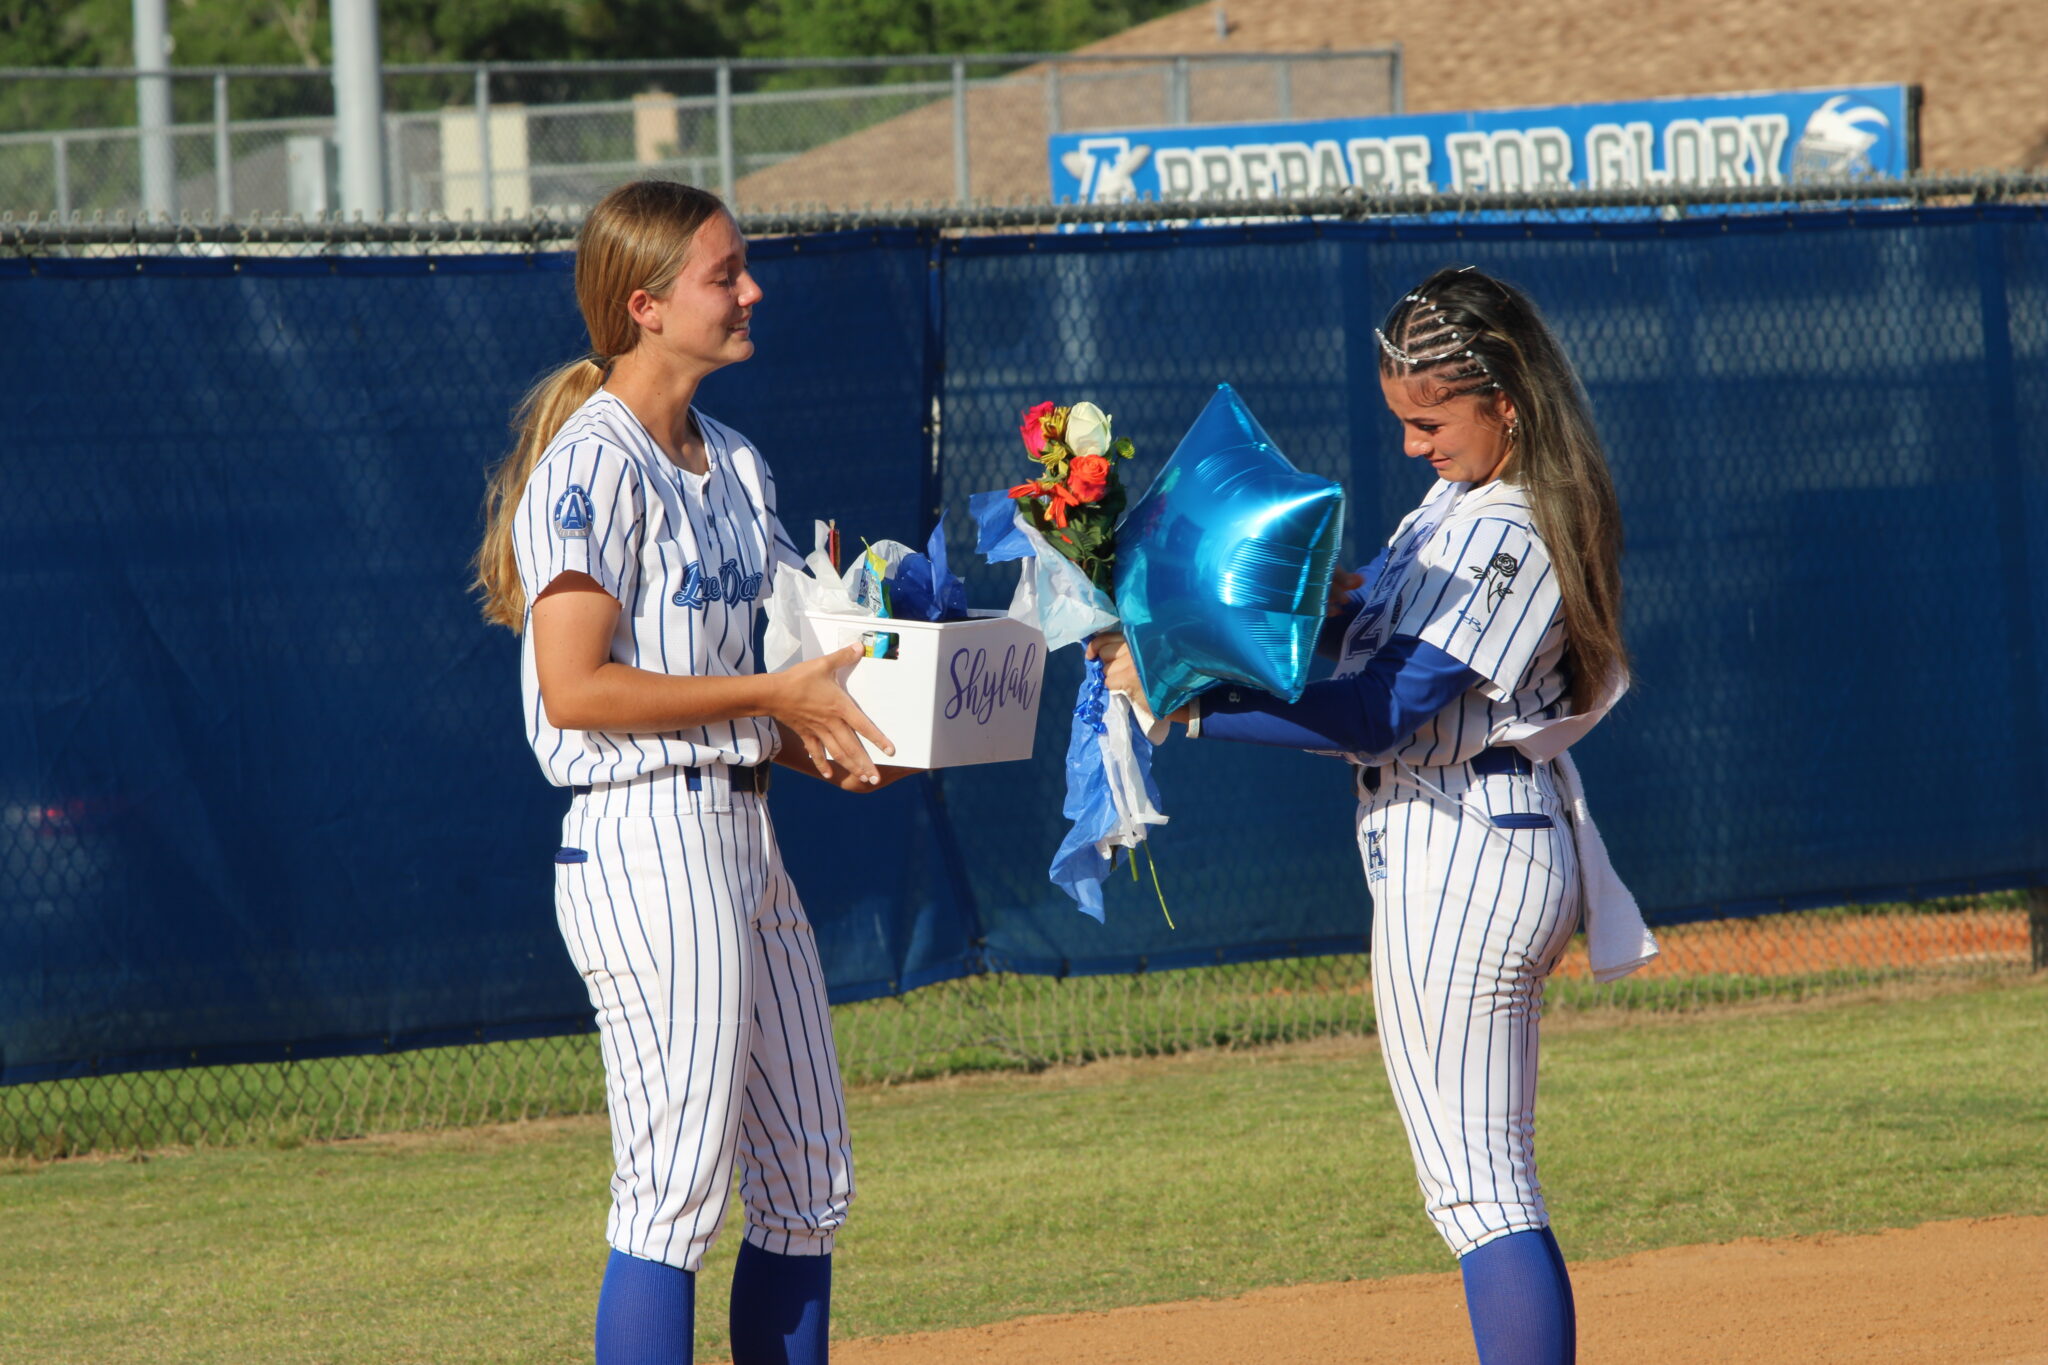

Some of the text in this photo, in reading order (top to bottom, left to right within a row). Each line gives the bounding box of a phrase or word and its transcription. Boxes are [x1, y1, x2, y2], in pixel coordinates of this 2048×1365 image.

[1155, 114, 1788, 203] PREPARE FOR GLORY
[561, 493, 587, 530] A
[944, 642, 1038, 725] Shylah
